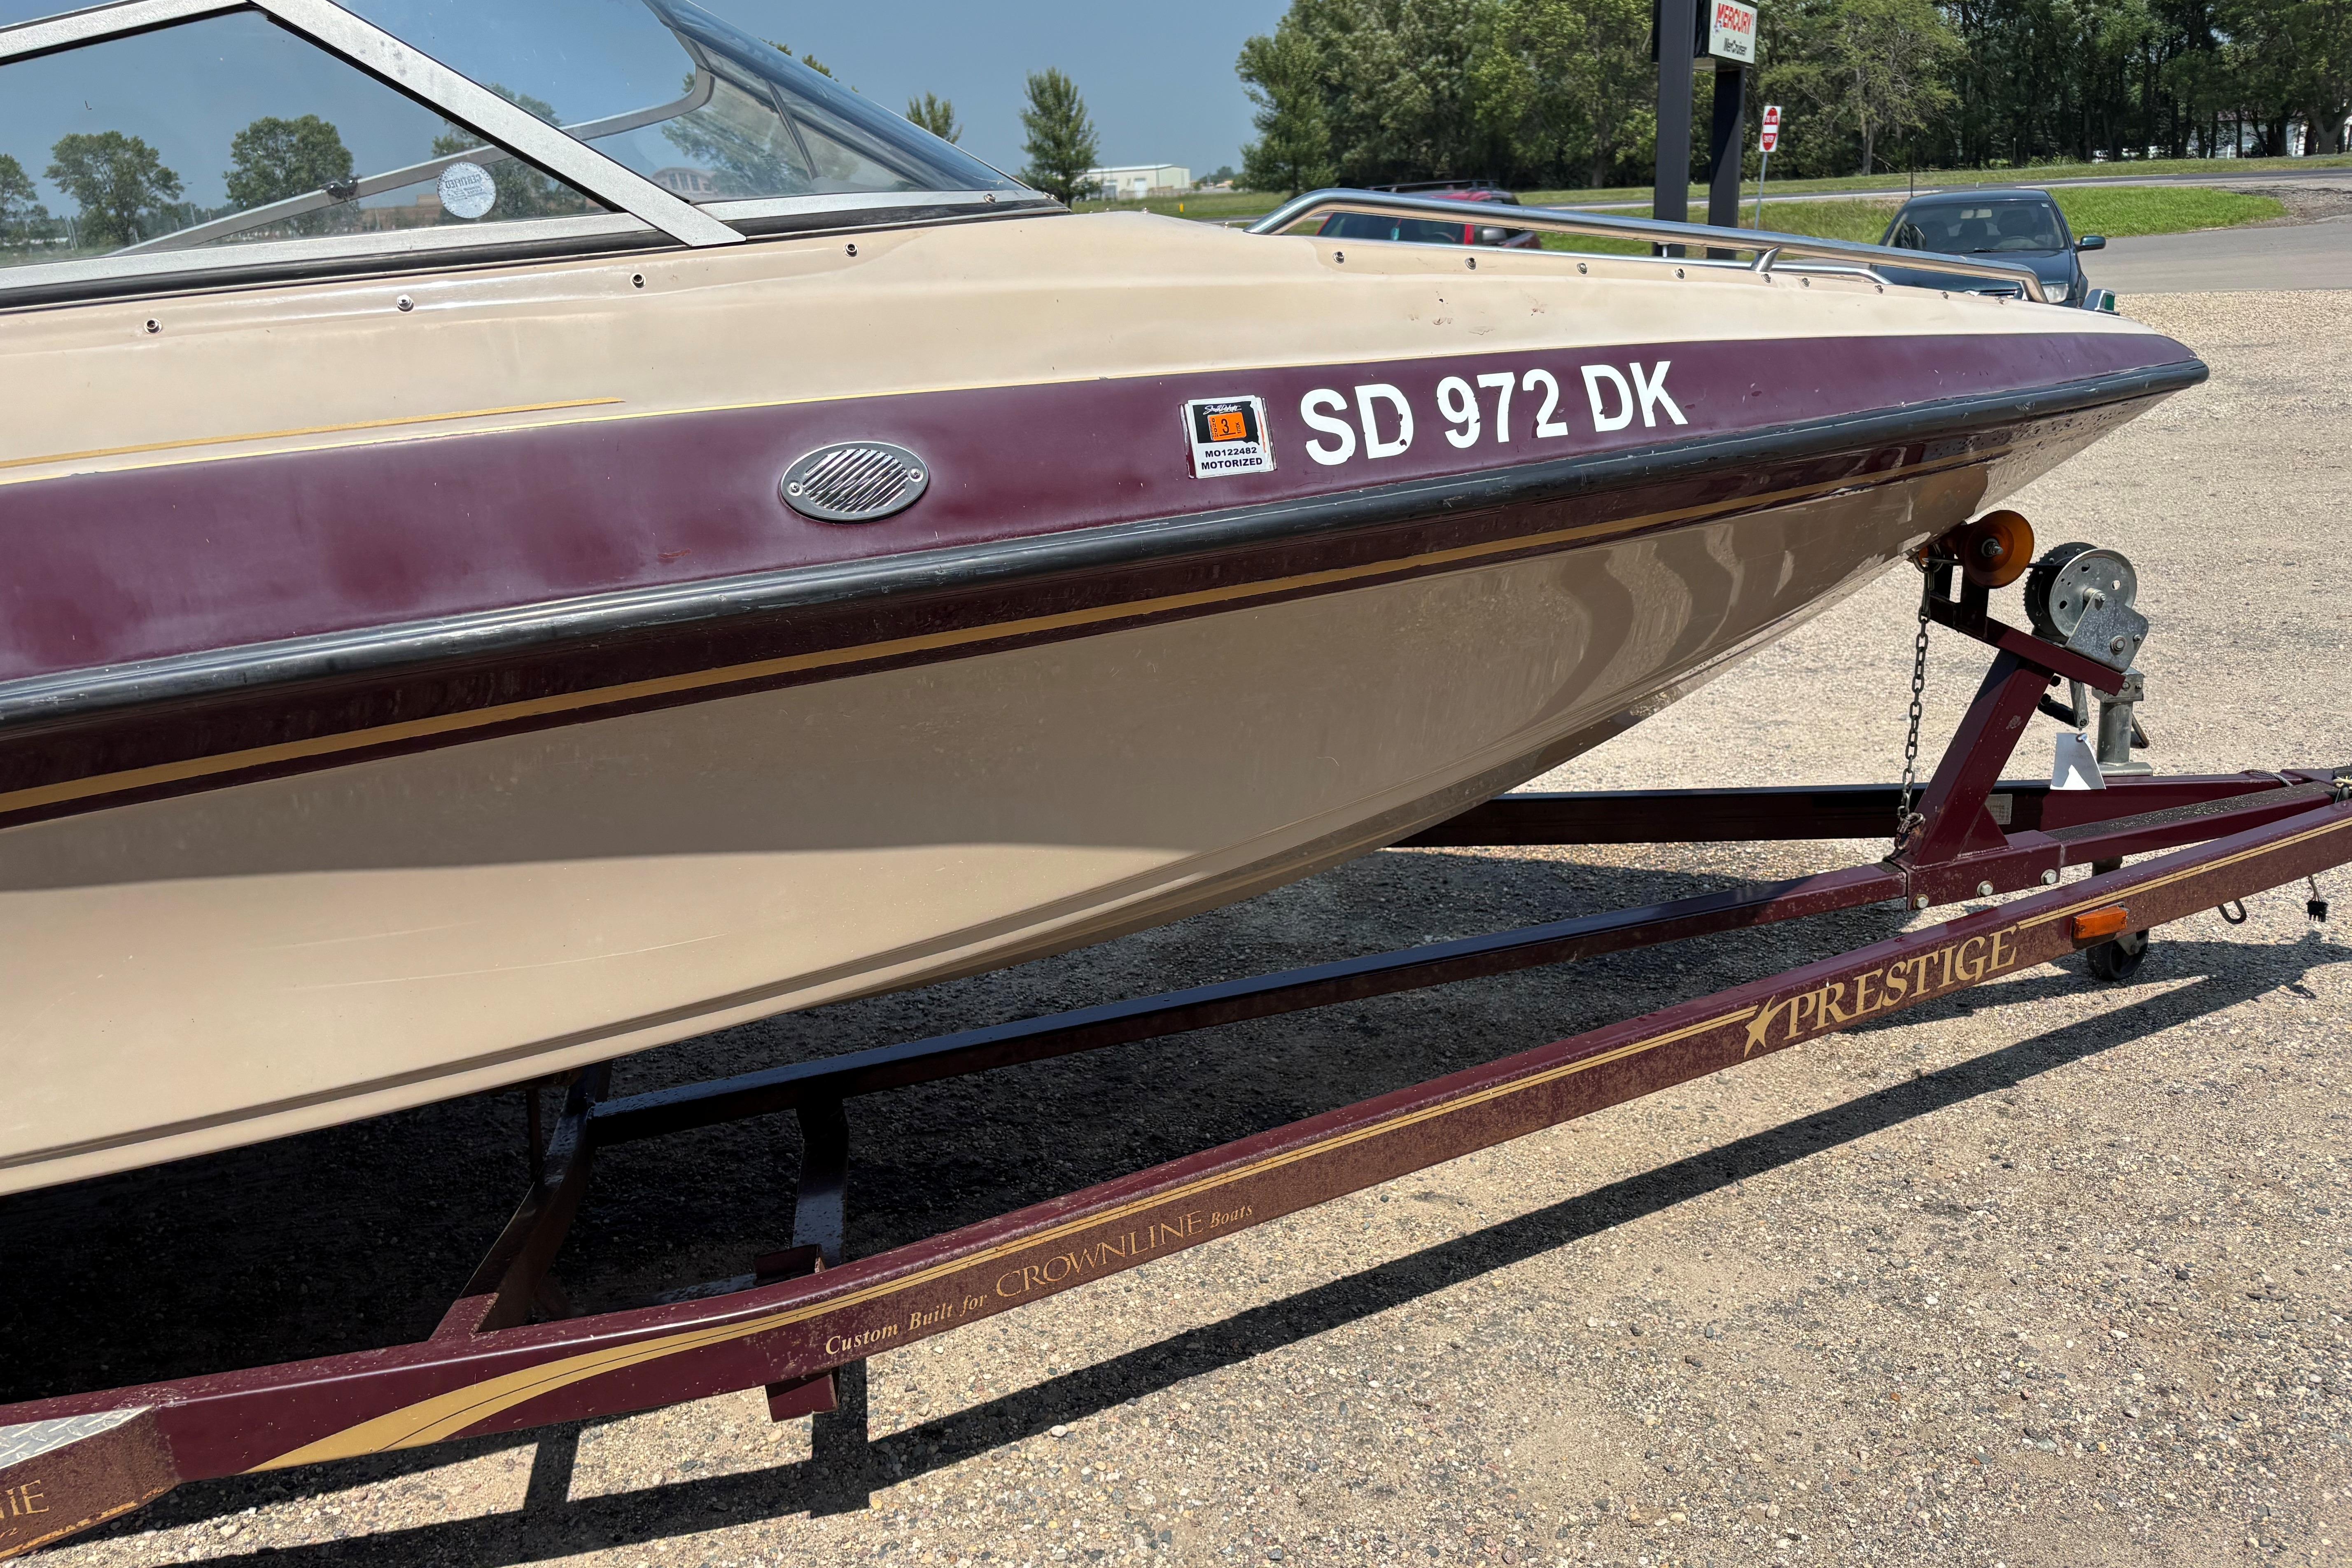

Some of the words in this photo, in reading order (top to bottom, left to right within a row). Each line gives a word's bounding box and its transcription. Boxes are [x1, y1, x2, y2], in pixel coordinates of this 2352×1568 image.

[1716, 3, 1752, 35] MERCURY
[1221, 418, 1230, 434] 3
[1300, 383, 1414, 466] SD
[1436, 369, 1568, 449] 972
[1580, 360, 1689, 432] DK
[1201, 457, 1262, 470] MOTORIZED
[1205, 447, 1257, 458] MO122482
[1783, 925, 2018, 1041] PRESTIGE
[825, 1323, 898, 1355] Custom
[908, 1302, 953, 1332] Built
[959, 1294, 988, 1317] for
[996, 1211, 1204, 1297] CROWNLINE
[1210, 1205, 1253, 1229] Boats
